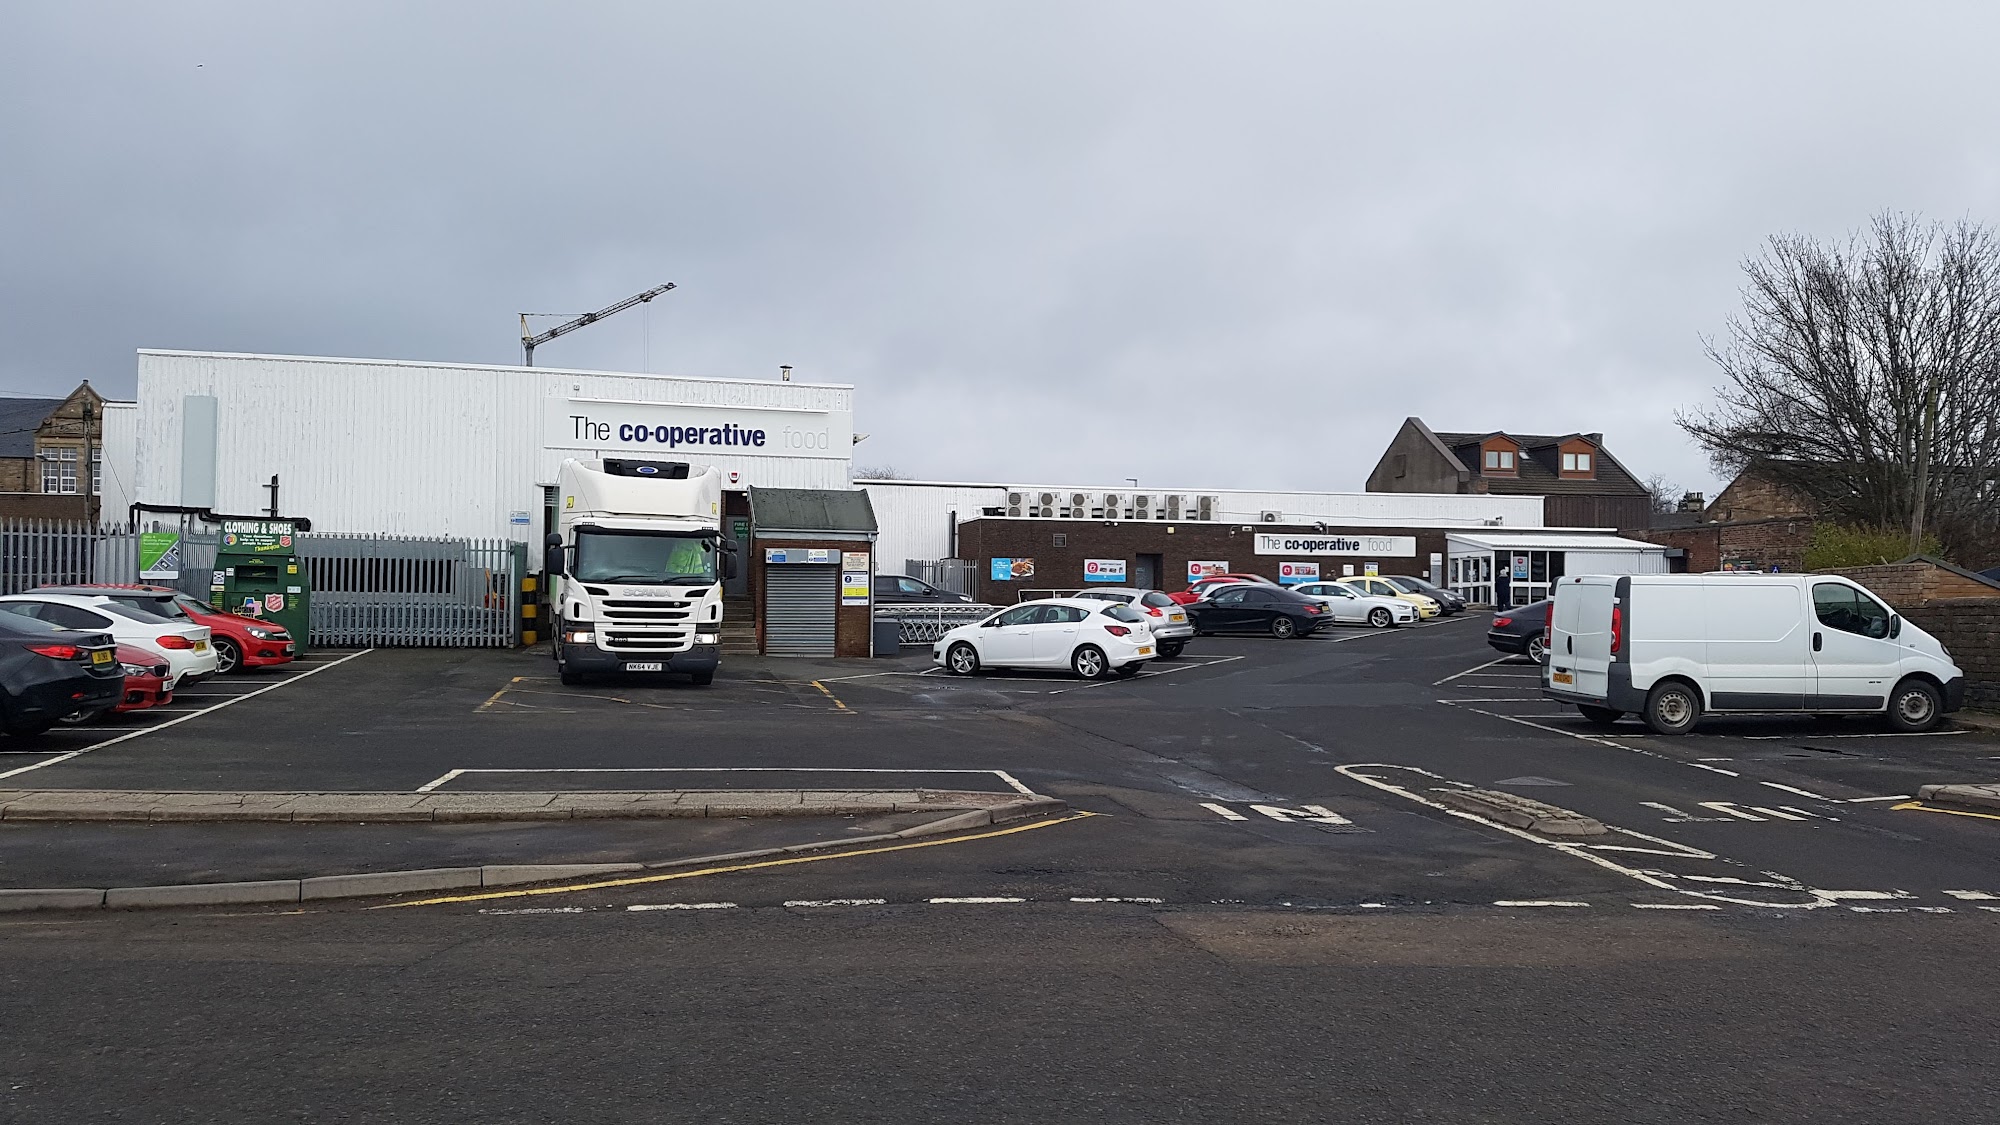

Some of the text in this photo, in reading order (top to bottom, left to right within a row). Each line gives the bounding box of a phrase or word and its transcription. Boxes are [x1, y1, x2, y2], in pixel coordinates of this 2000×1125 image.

[570, 415, 829, 450] The co-operative food
[224, 521, 292, 535] CLOTHING & SHOES
[1260, 535, 1393, 553] The co-operative food
[623, 588, 672, 597] SCANIA
